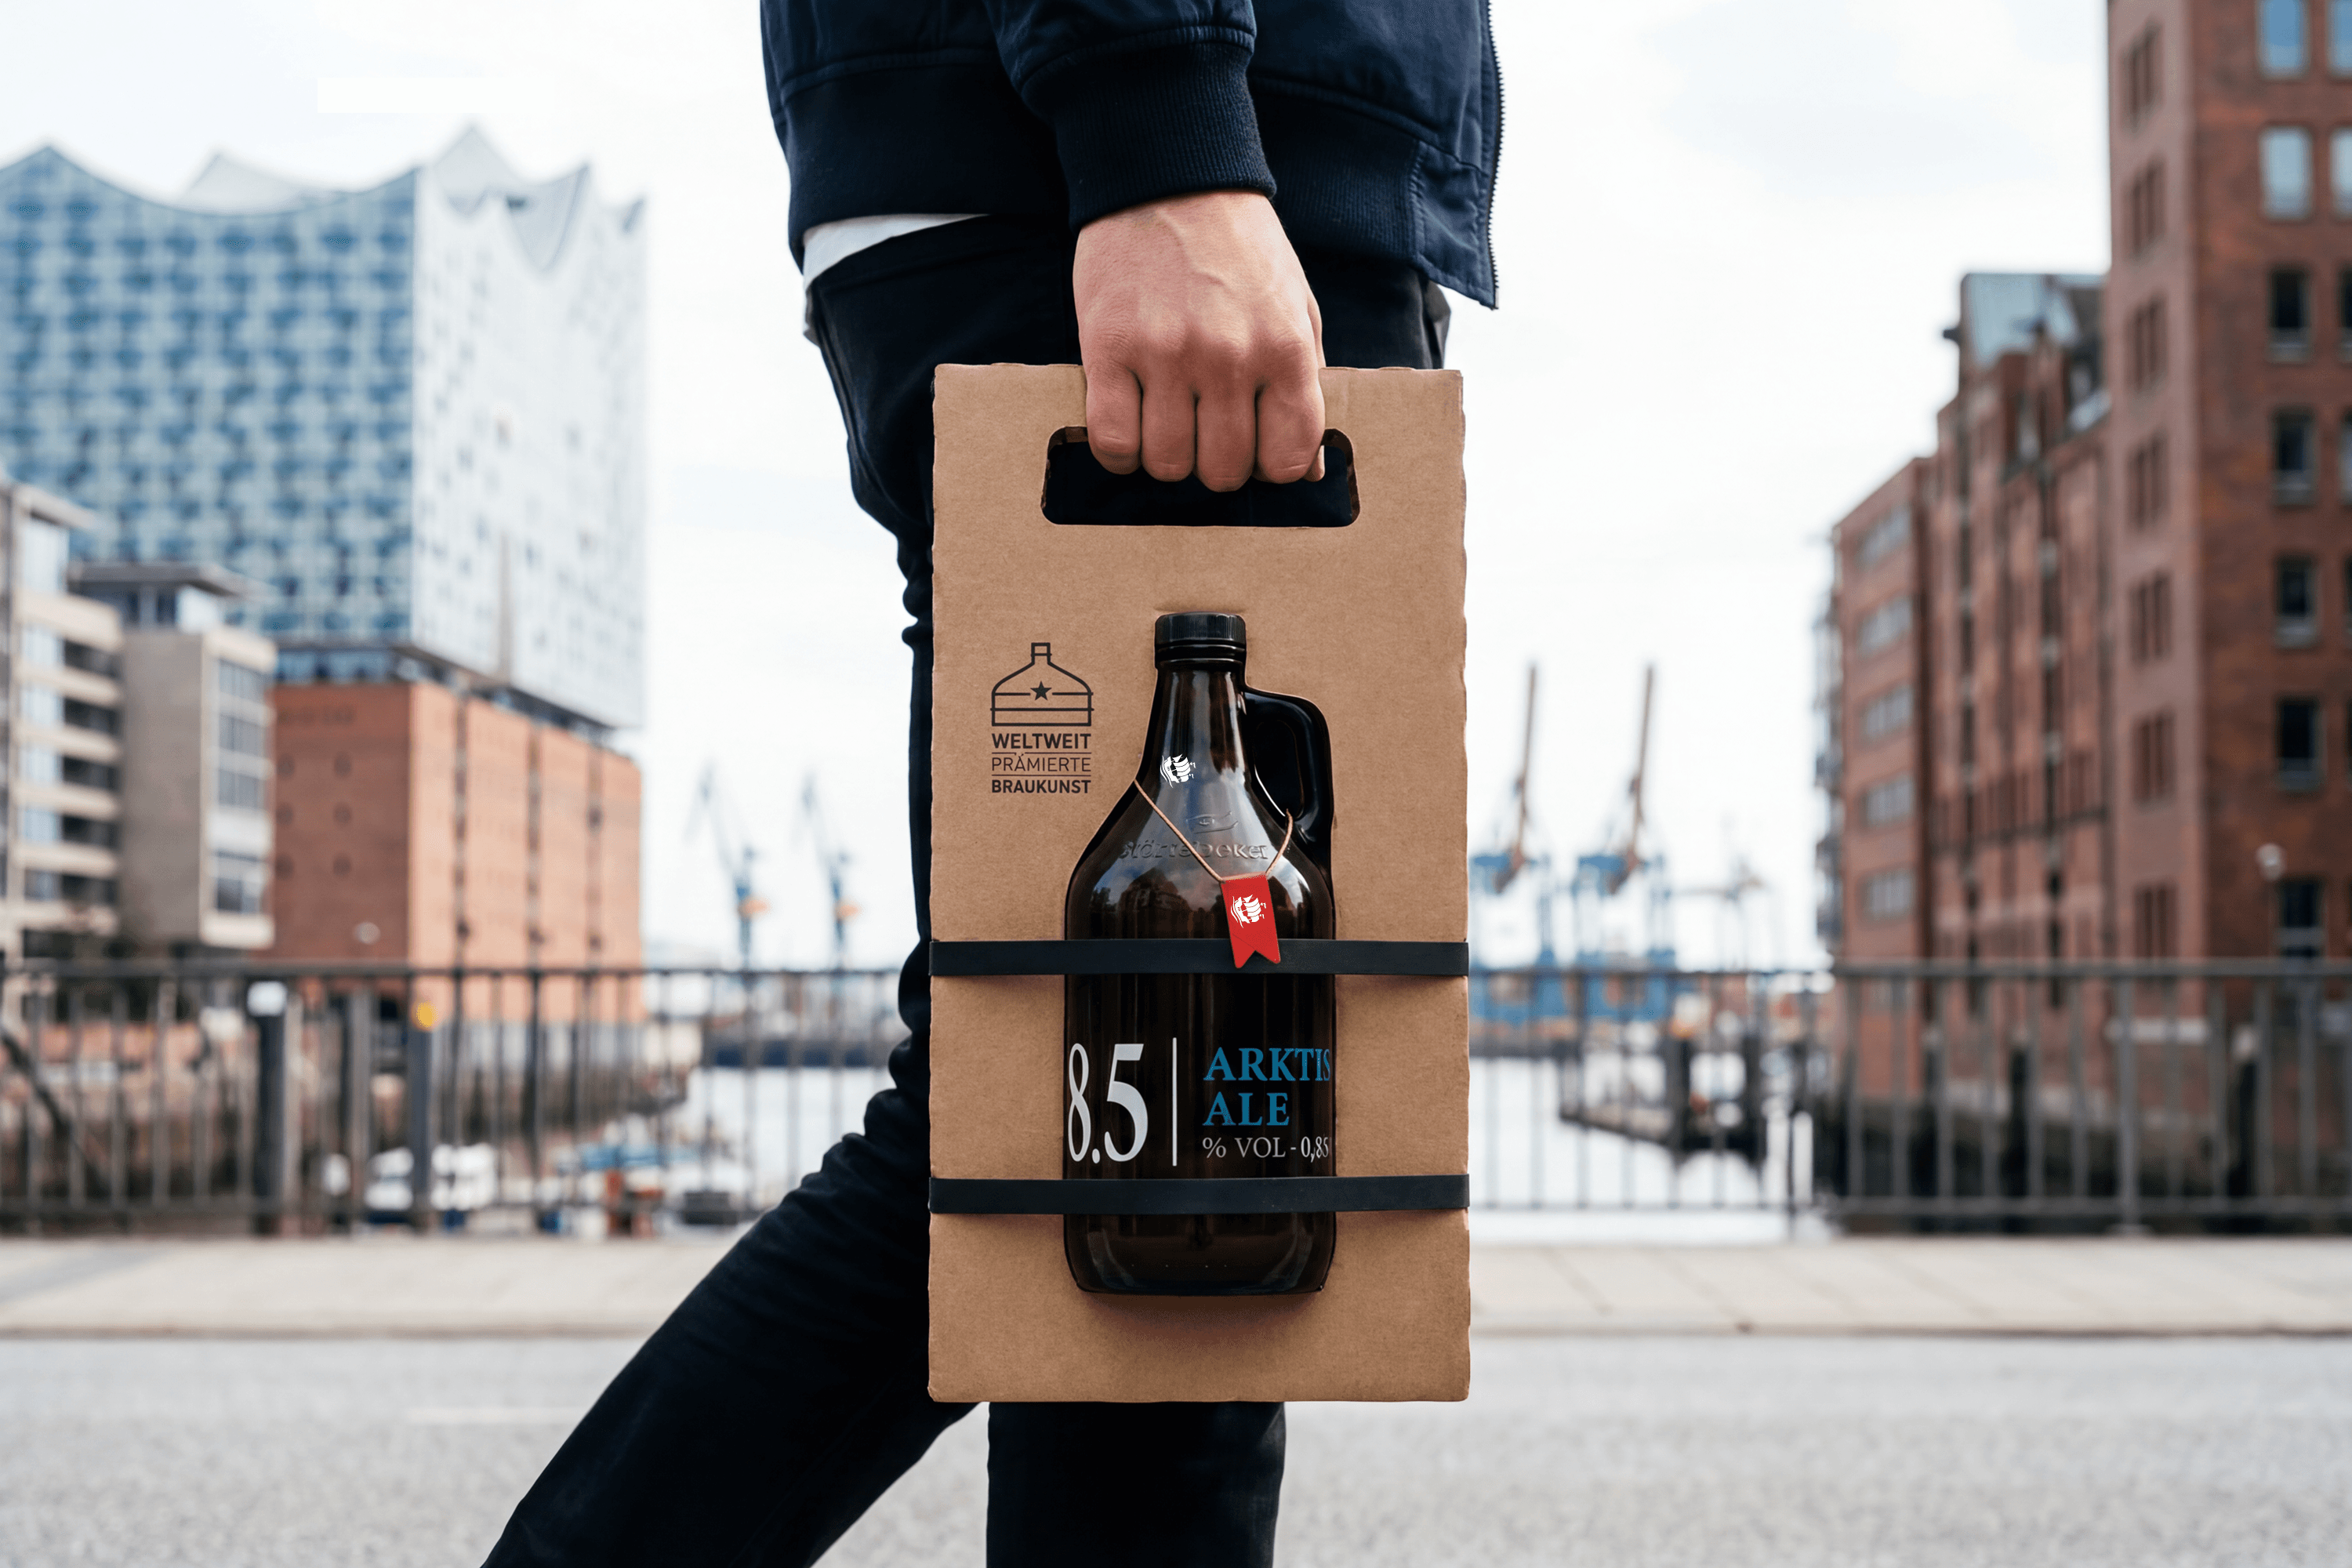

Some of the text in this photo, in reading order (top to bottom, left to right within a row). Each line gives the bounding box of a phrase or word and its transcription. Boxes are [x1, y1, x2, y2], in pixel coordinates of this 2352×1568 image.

[991, 733, 1091, 749] WELTWEIT
[992, 753, 1091, 772] PRÄMIERTE
[991, 779, 1091, 793] BRAUKUNST
[1203, 1047, 1331, 1081] ARKTIS
[1068, 1043, 1149, 1163] 8.5
[1203, 1091, 1290, 1126] ALE
[1202, 1137, 1227, 1159] %
[1234, 1137, 1286, 1158] VOL
